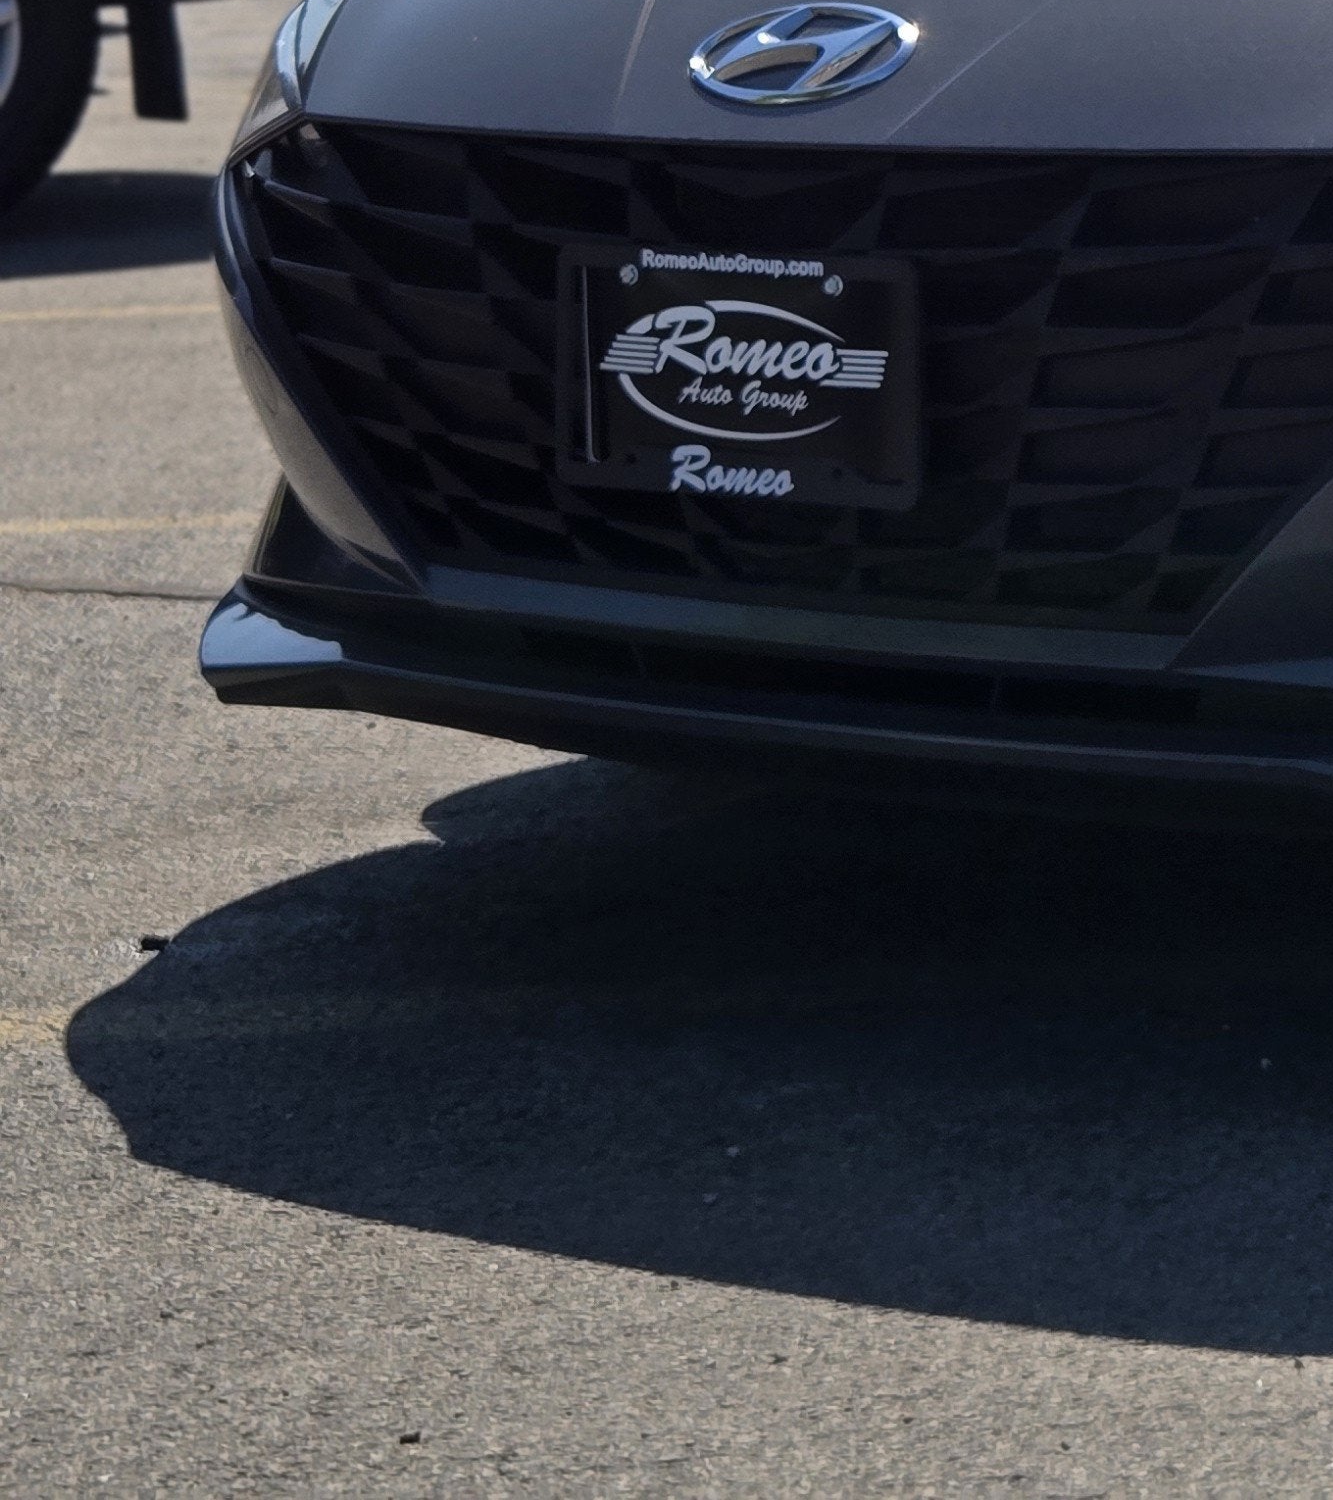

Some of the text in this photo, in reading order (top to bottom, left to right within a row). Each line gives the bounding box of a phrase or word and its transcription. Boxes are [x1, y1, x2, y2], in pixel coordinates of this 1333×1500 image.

[641, 248, 825, 279] RomeoAutoGroup.com
[654, 305, 840, 380] Romeo
[678, 377, 809, 416] Auto Group
[669, 444, 795, 497] Romeo
